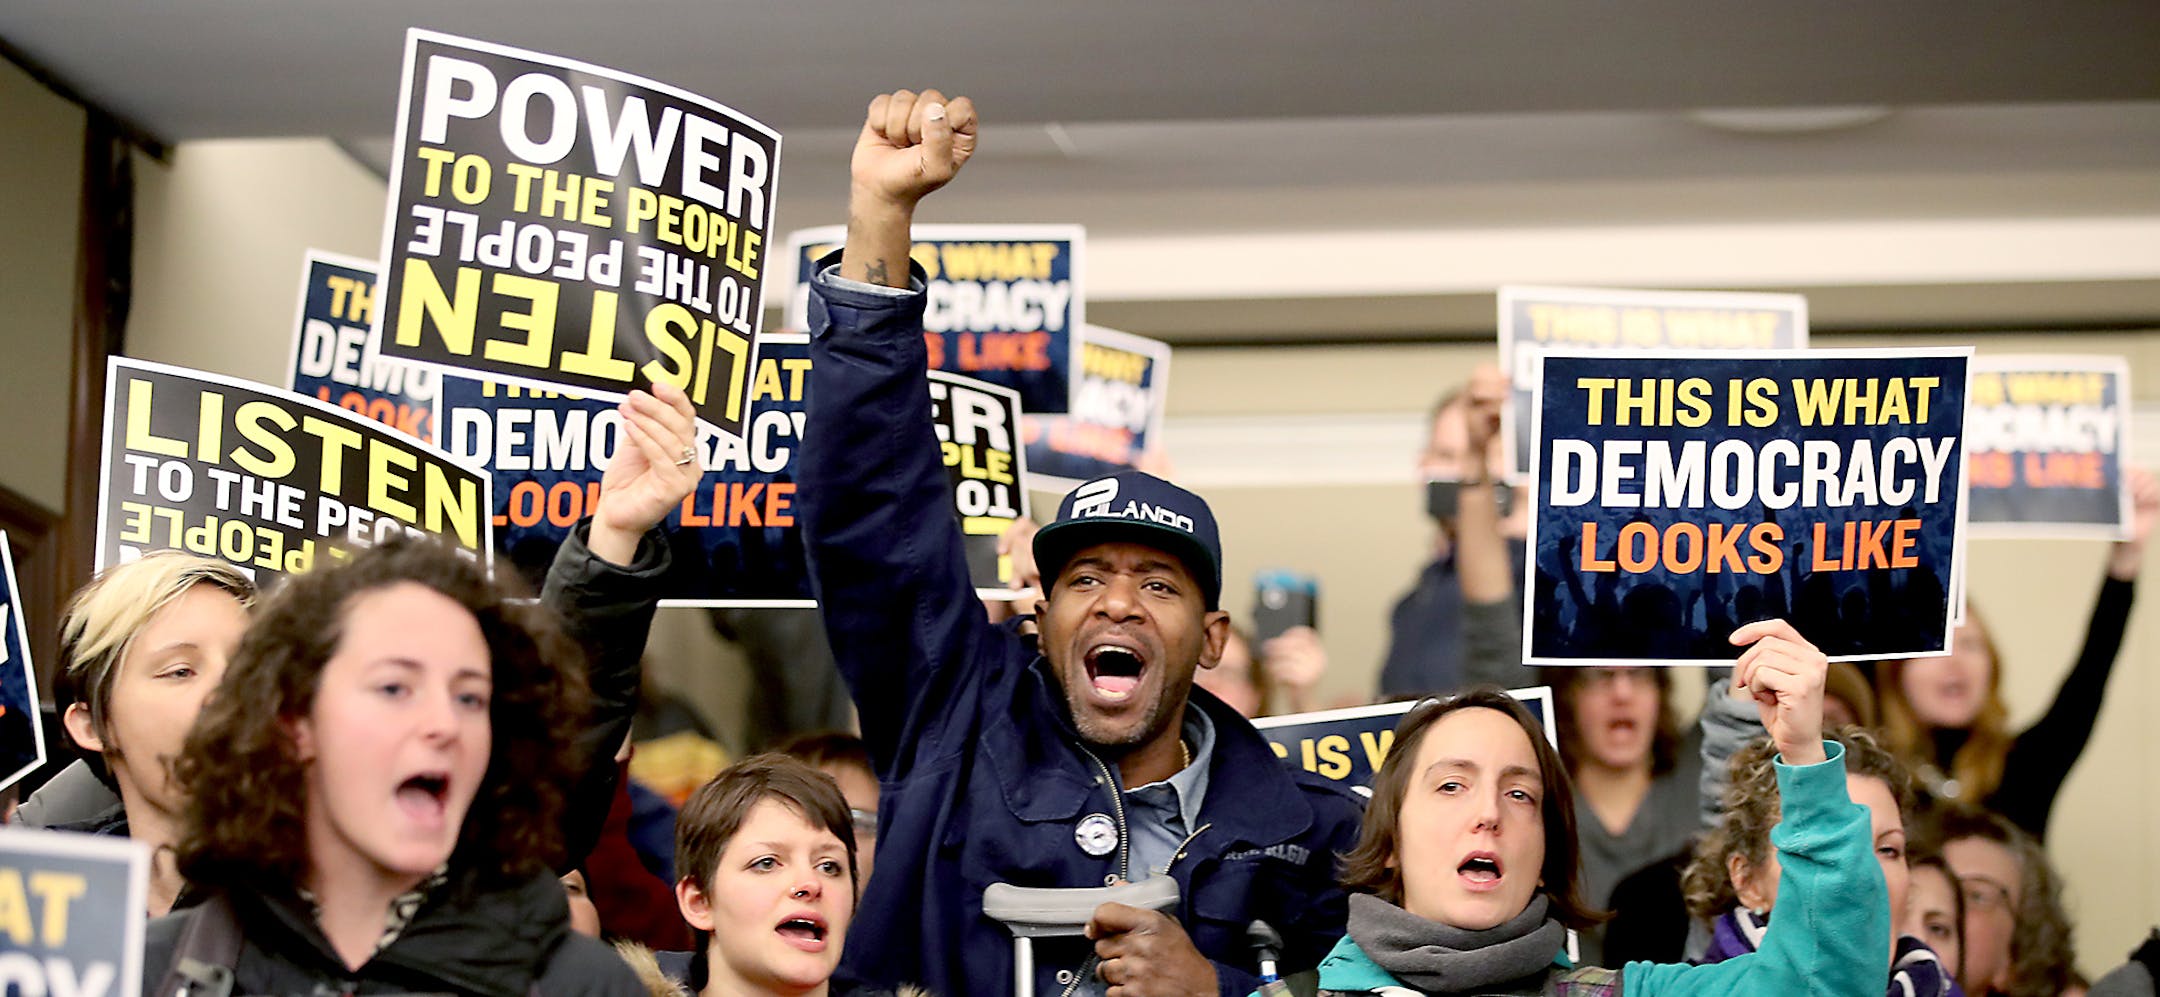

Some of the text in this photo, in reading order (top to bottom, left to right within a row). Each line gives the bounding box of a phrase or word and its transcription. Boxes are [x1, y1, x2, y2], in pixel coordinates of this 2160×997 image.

[420, 55, 768, 230] POWER
[417, 147, 762, 280] TO THE PEOPLE
[407, 205, 752, 334] TO THE PEOPLE
[910, 242, 1059, 282] S WHAT
[327, 275, 377, 325] TH
[923, 279, 1070, 332] CRACY
[395, 258, 750, 422] LISTEN
[958, 331, 1051, 372] LIKE
[752, 358, 813, 401] AT
[1576, 376, 1940, 428] THIS IS WHAT
[125, 378, 479, 549] LISTEN
[451, 406, 807, 474] DEMOAC
[941, 441, 1014, 485] PLE
[124, 454, 194, 502] TO
[207, 468, 306, 529] THE
[1550, 436, 1956, 511] DEMOCRACY
[680, 482, 797, 528] LIKE
[120, 501, 315, 575] PEOPLE
[1580, 518, 1922, 575] LOOKS LIKE
[1300, 734, 1352, 781] IS
[0, 868, 87, 949] AT
